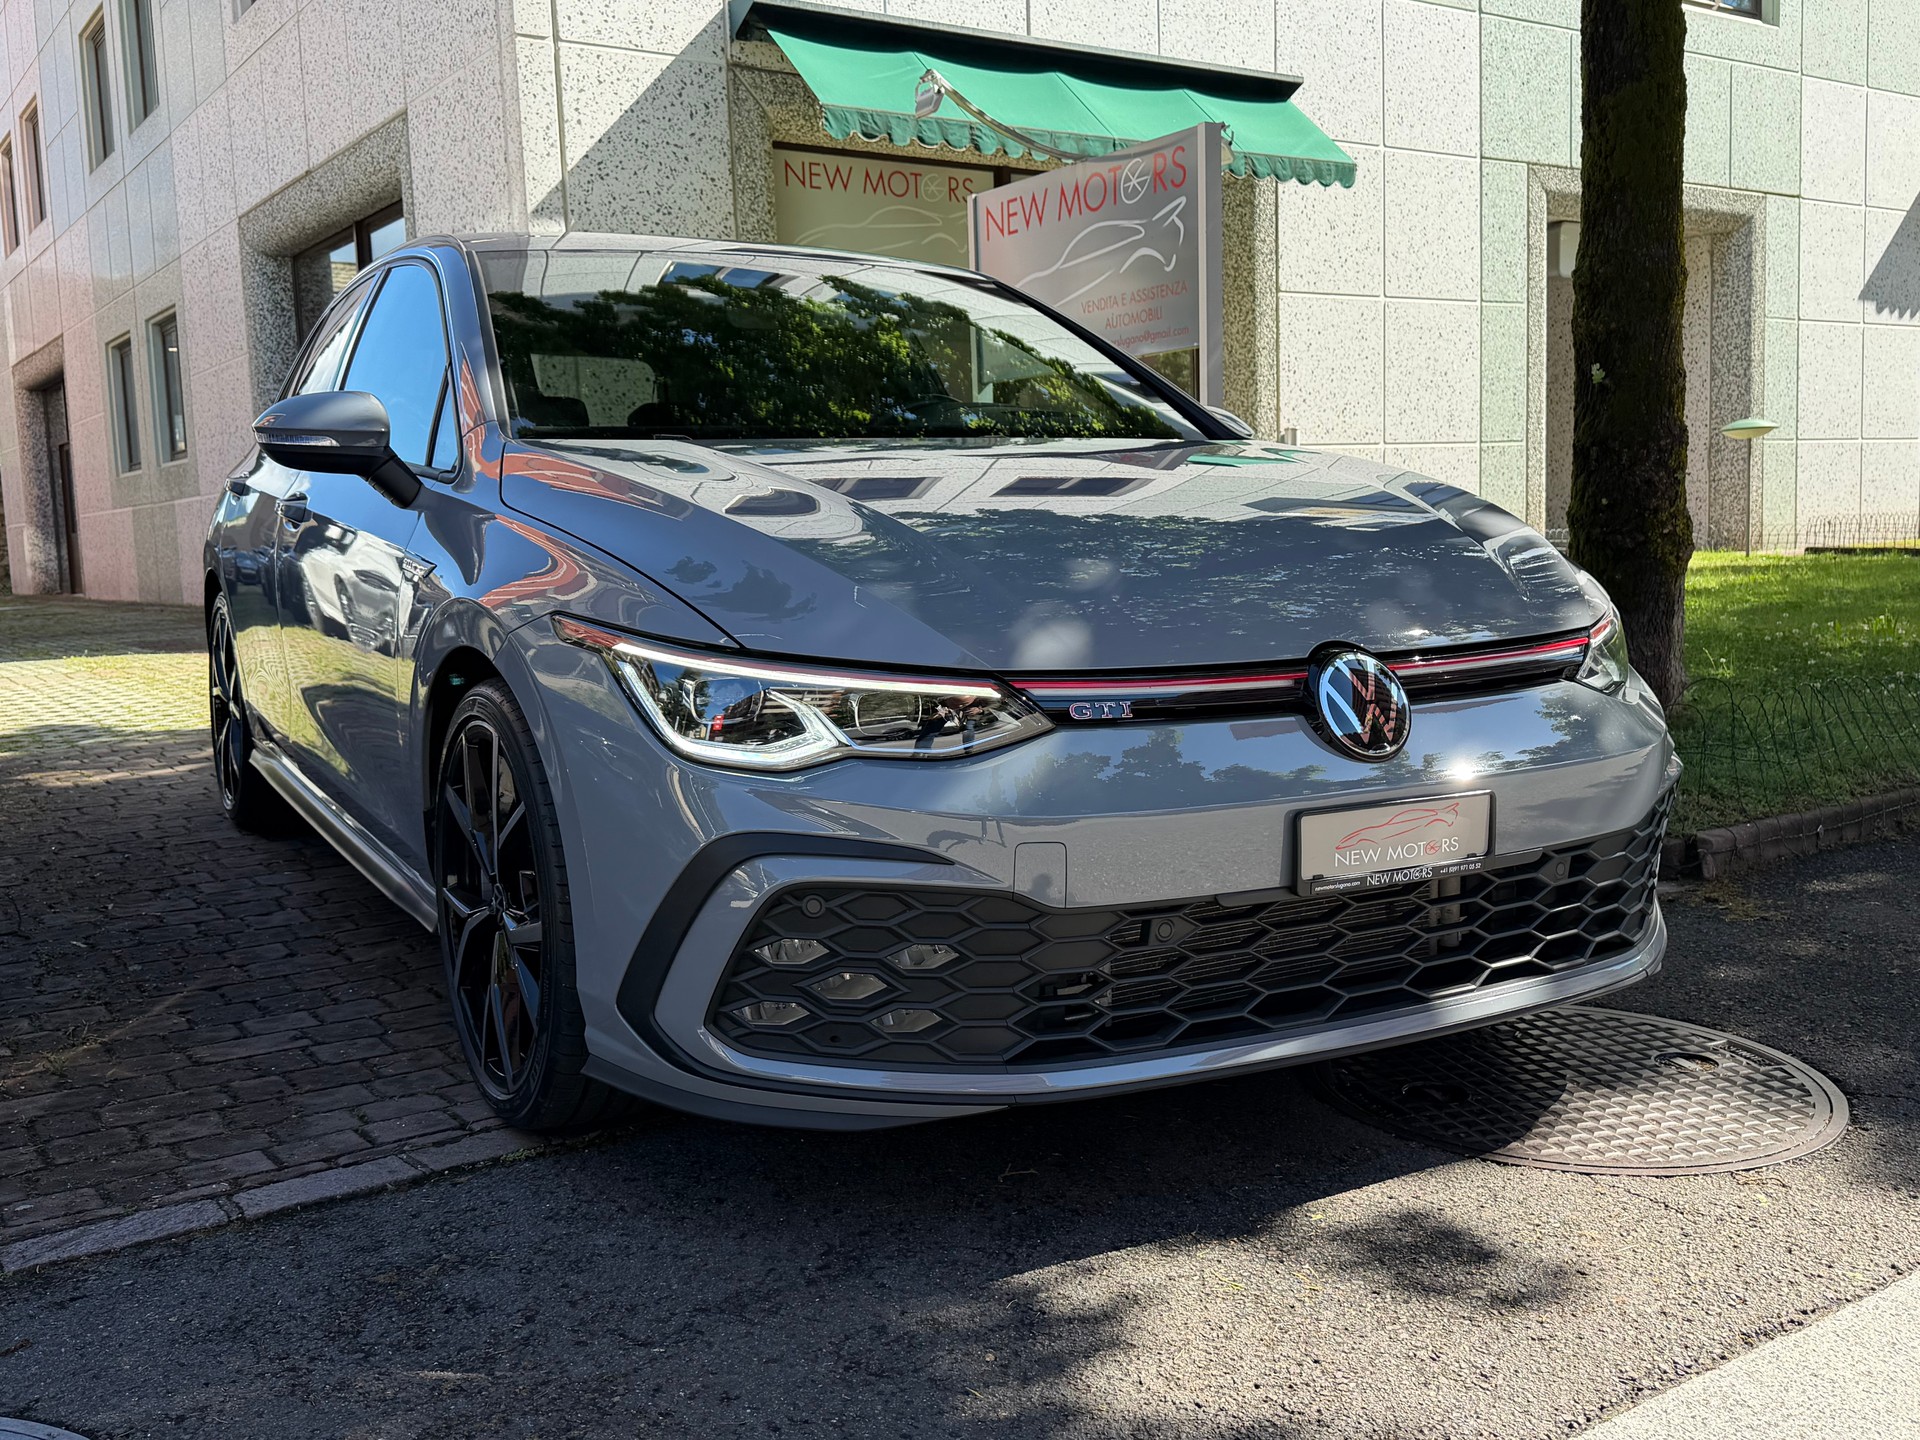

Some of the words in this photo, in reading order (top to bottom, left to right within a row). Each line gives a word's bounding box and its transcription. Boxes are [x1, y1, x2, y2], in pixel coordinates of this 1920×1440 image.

[784, 159, 852, 192] NEW
[863, 167, 974, 203] MOTORS
[985, 188, 1048, 242] NEW
[1058, 146, 1187, 222] MOTORS
[1081, 295, 1119, 314] VENDITA
[1122, 292, 1127, 306] E
[1130, 280, 1188, 304] ASSISTENZA
[1105, 306, 1163, 329] AUTOMOBILI
[1069, 701, 1133, 720] GTI
[1334, 847, 1381, 867] NEW
[1387, 837, 1459, 861] MOTORS
[1367, 872, 1394, 886] NEW
[1393, 867, 1433, 883] MOTORS
